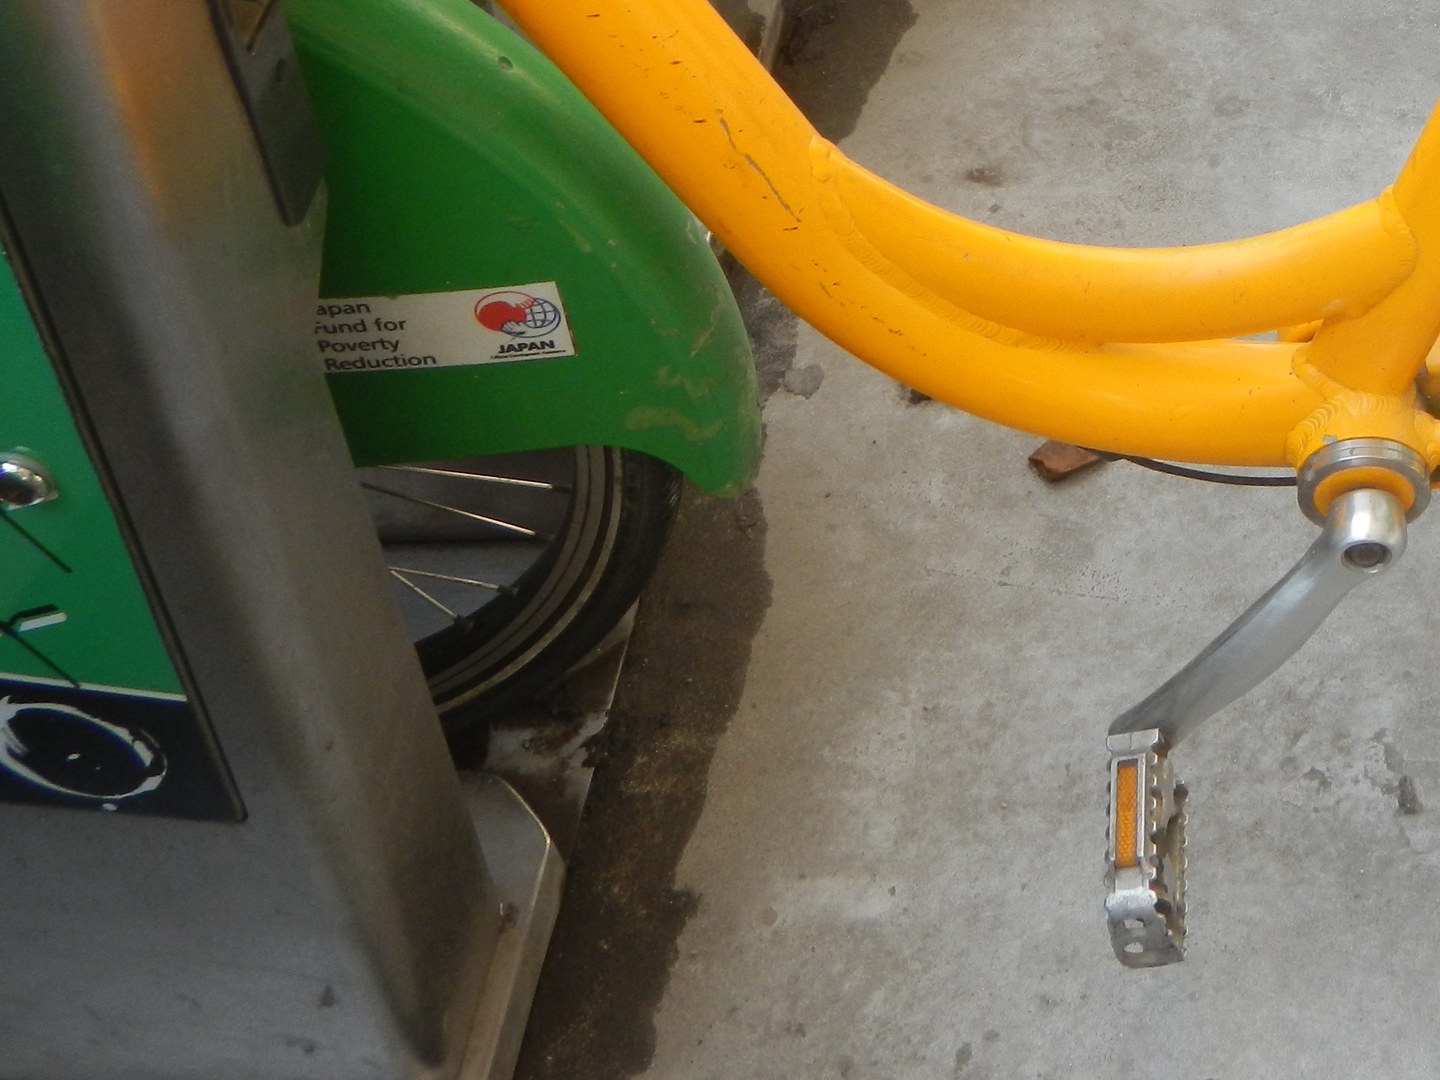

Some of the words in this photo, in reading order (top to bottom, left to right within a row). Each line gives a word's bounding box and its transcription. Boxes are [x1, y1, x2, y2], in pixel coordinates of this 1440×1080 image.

[316, 303, 371, 318] apan
[374, 317, 407, 331] for
[318, 338, 400, 353] Poverty
[498, 340, 555, 354] JAPAN
[324, 353, 437, 371] Reduction
